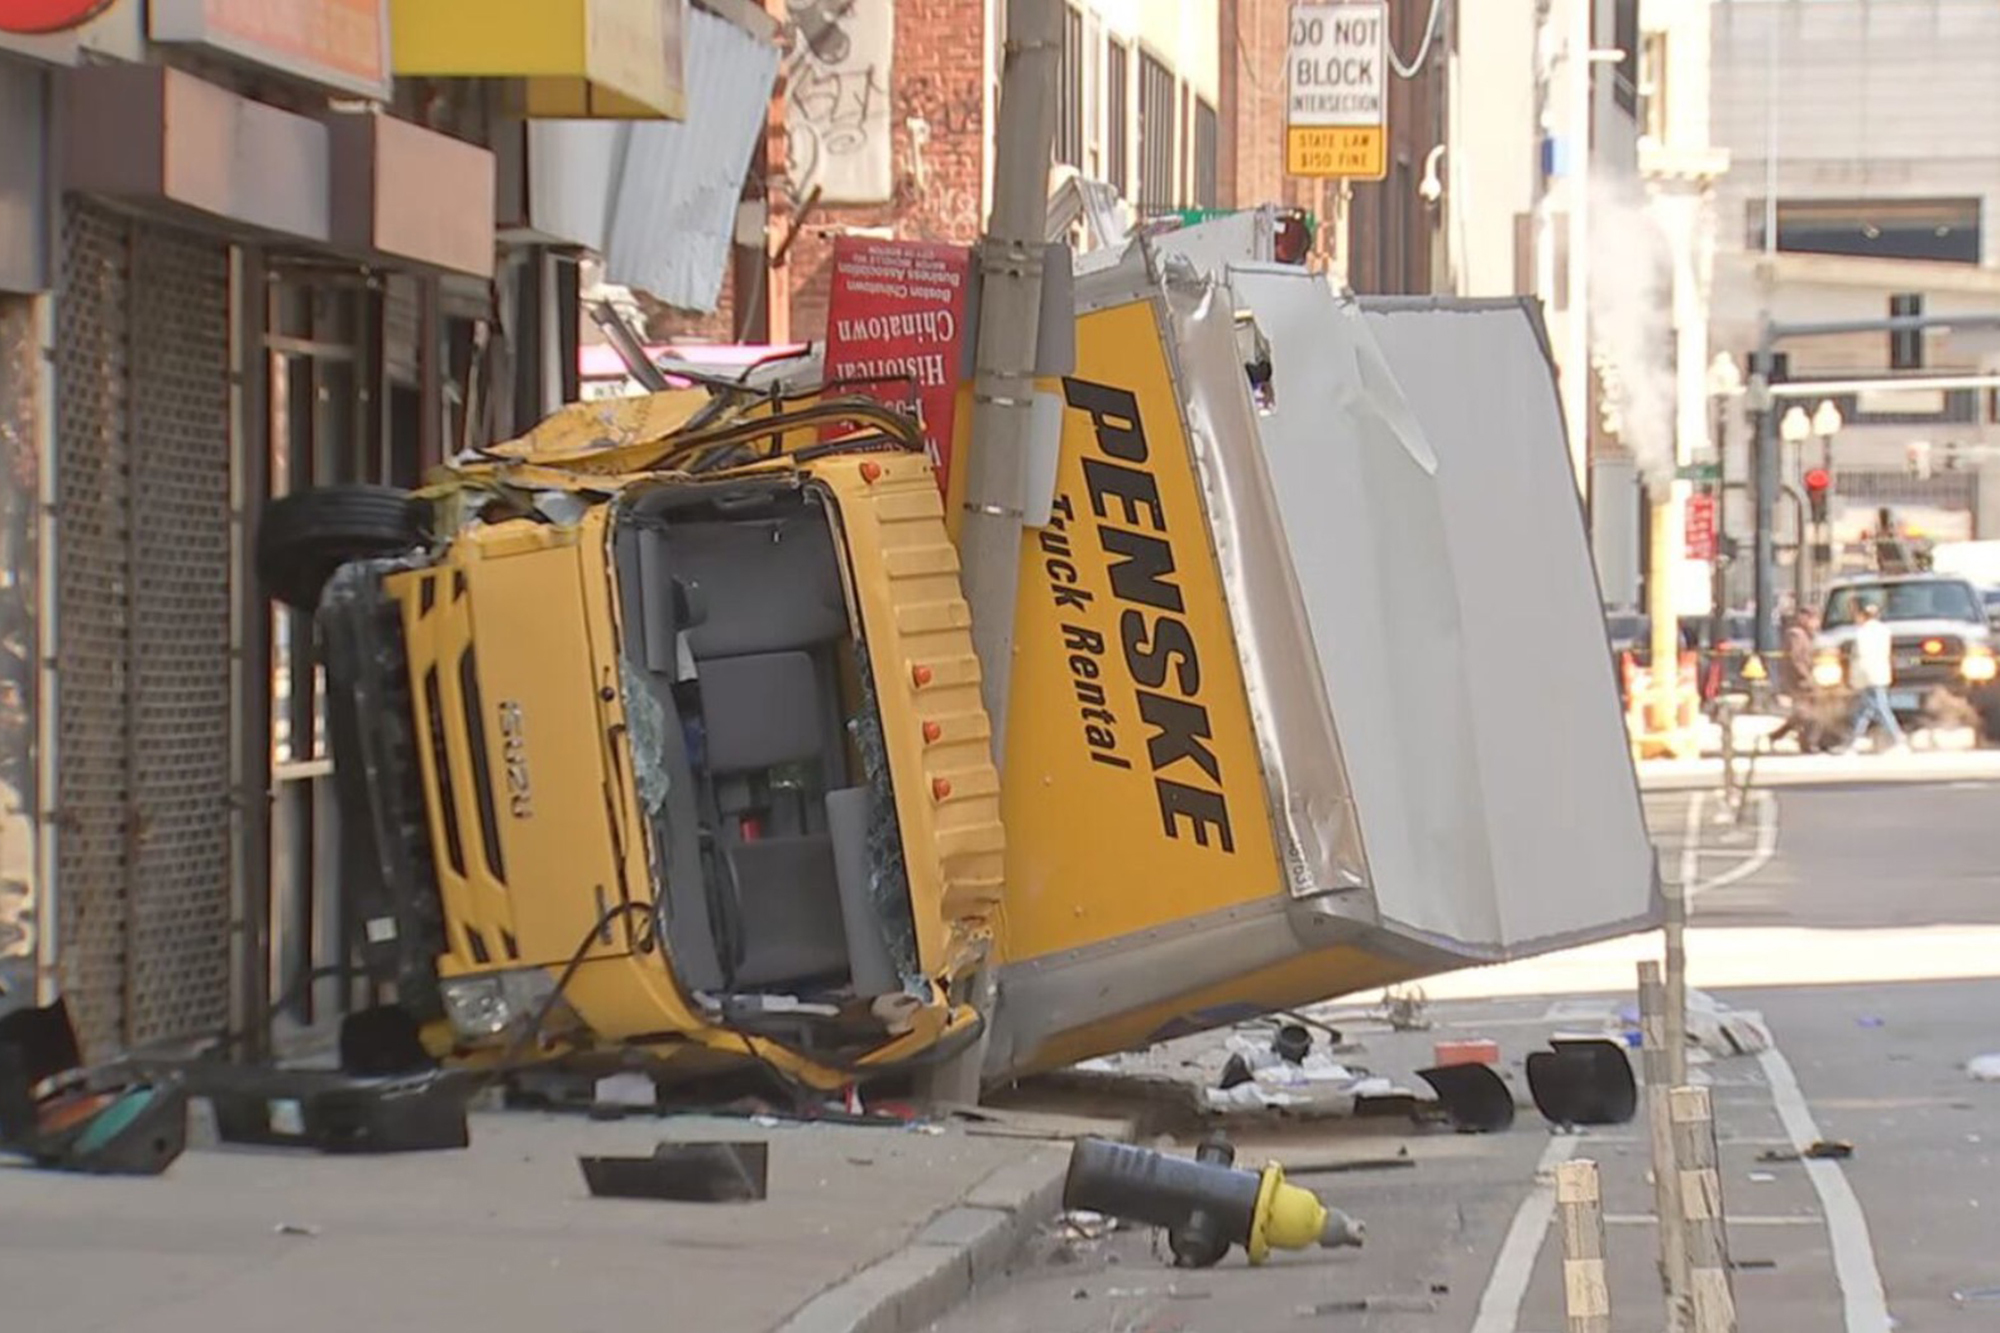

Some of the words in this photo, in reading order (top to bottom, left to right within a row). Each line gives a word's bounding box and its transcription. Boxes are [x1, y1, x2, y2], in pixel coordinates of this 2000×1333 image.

[1293, 18, 1324, 46] DO
[1335, 19, 1379, 46] NOT
[1297, 58, 1374, 87] BLOCK
[1299, 134, 1334, 147] STATE
[1343, 135, 1370, 147] LAW
[1339, 154, 1367, 167] FINE
[838, 262, 906, 282] Association
[907, 268, 960, 288] Business
[846, 280, 908, 299] Chinatown
[909, 285, 952, 304] Boston
[837, 309, 954, 343] Chinatown
[1039, 494, 1094, 613] Truck
[1062, 377, 1235, 854] PENSKE
[1061, 623, 1132, 770] Rental
[499, 700, 534, 819] ISUZU
